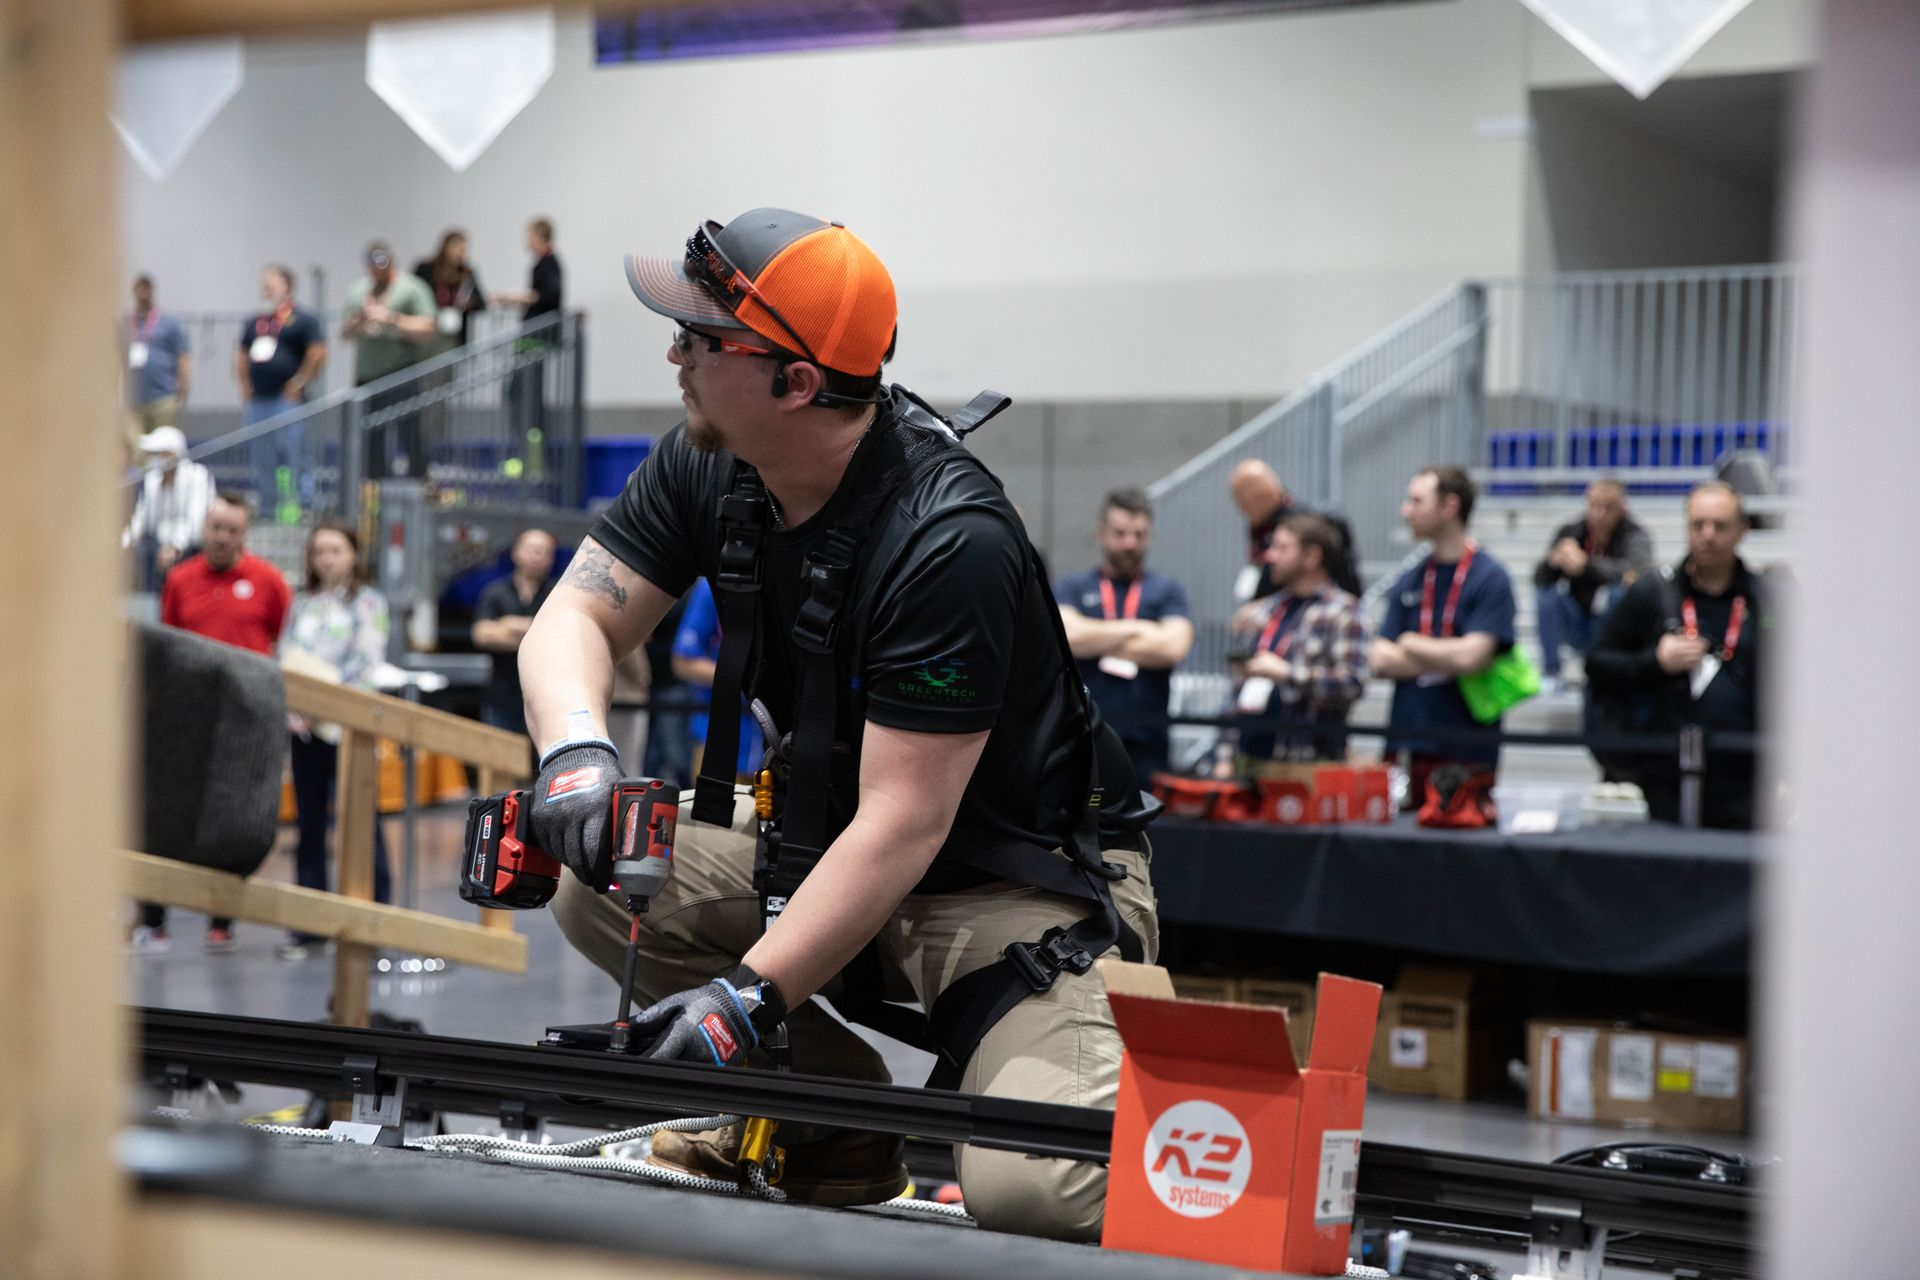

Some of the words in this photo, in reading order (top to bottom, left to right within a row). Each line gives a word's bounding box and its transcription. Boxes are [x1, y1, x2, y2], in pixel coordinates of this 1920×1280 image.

[896, 681, 976, 697] GREENTECH
[1151, 1127, 1243, 1183] K2
[1169, 1185, 1231, 1209] systems
